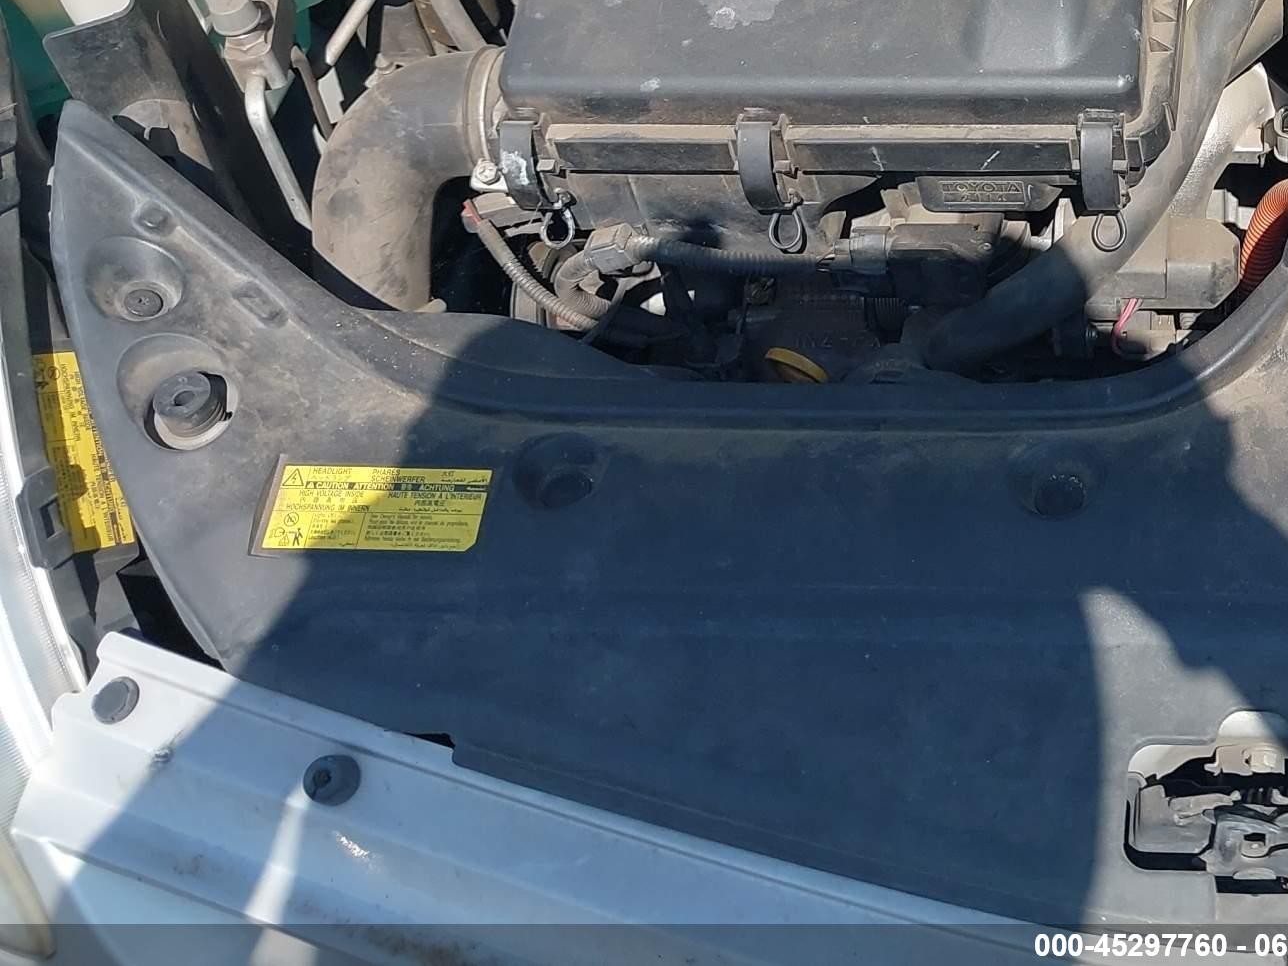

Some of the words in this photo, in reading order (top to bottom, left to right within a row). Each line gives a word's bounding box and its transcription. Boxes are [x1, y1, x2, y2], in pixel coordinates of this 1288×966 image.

[941, 181, 1021, 192] TOYOTA
[312, 467, 353, 475] HEADLIGHT
[371, 475, 426, 483] SCHEINWERFER
[418, 484, 455, 492] ACHTUNG
